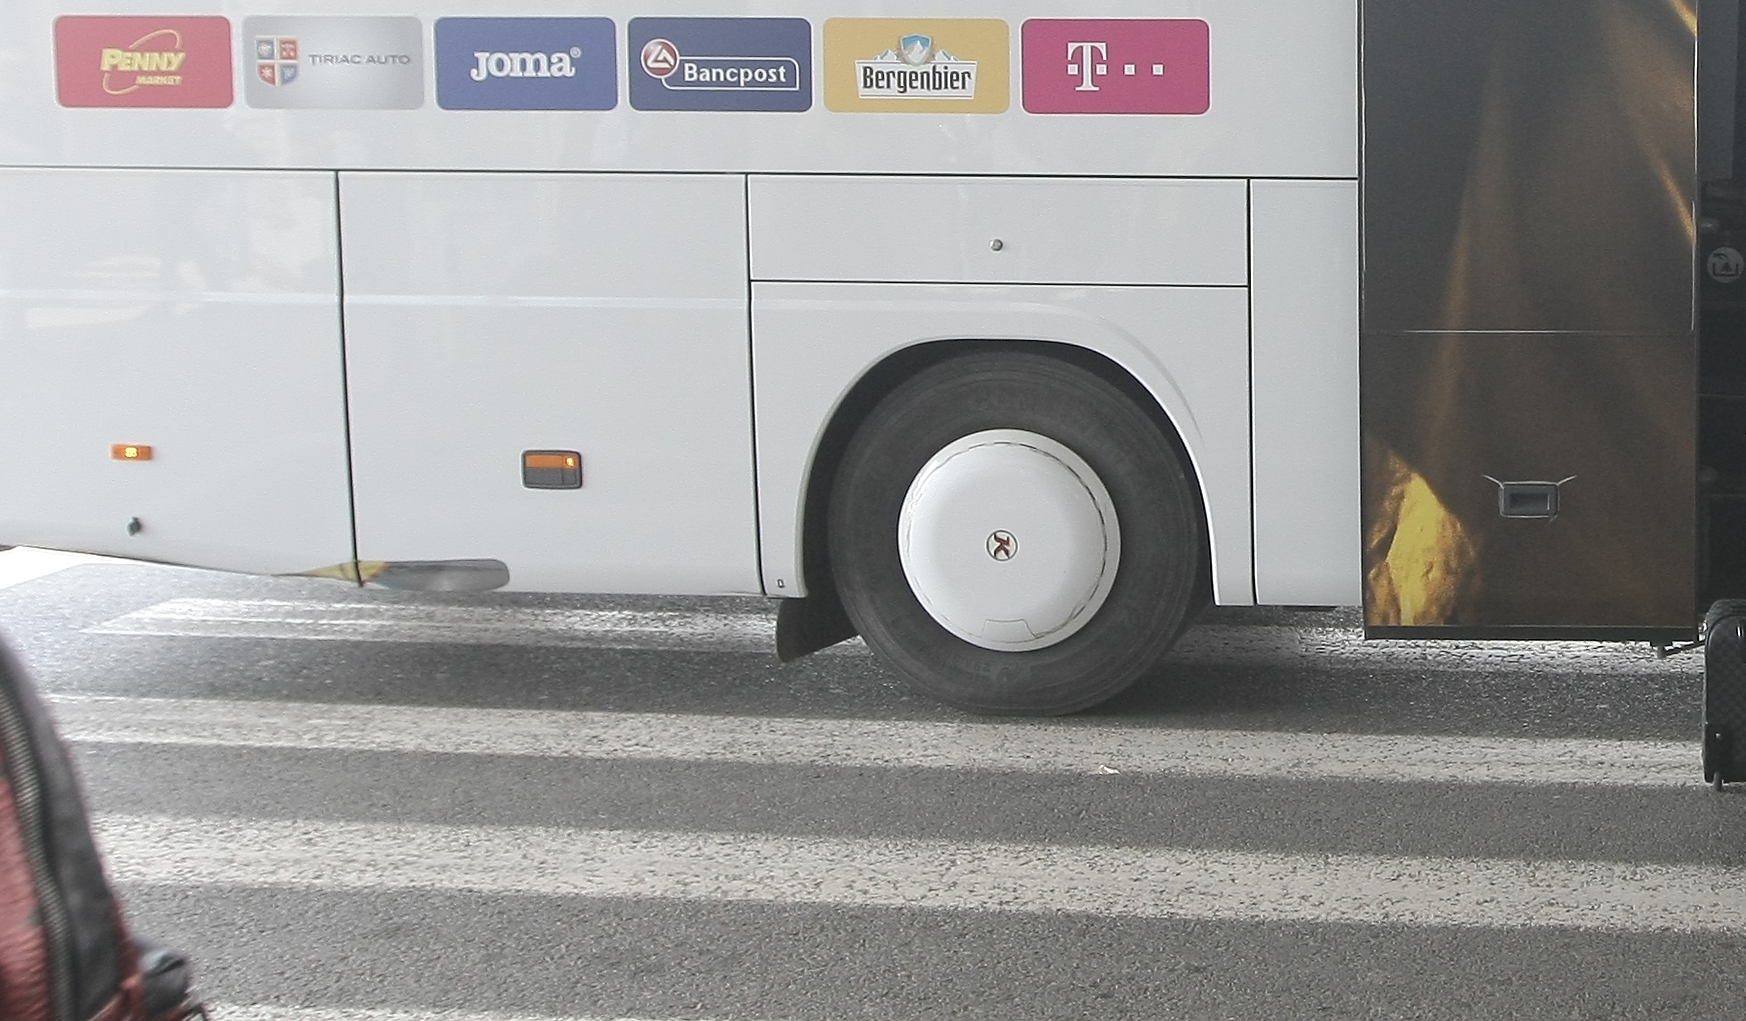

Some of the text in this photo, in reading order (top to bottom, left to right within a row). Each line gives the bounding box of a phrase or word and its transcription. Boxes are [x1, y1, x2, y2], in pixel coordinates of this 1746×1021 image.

[100, 48, 186, 72] PENNY
[308, 53, 411, 66] TIRIAC AUTO
[134, 75, 183, 85] MARKET
[684, 62, 787, 86] Bancpost
[861, 66, 972, 94] Bergenbier
